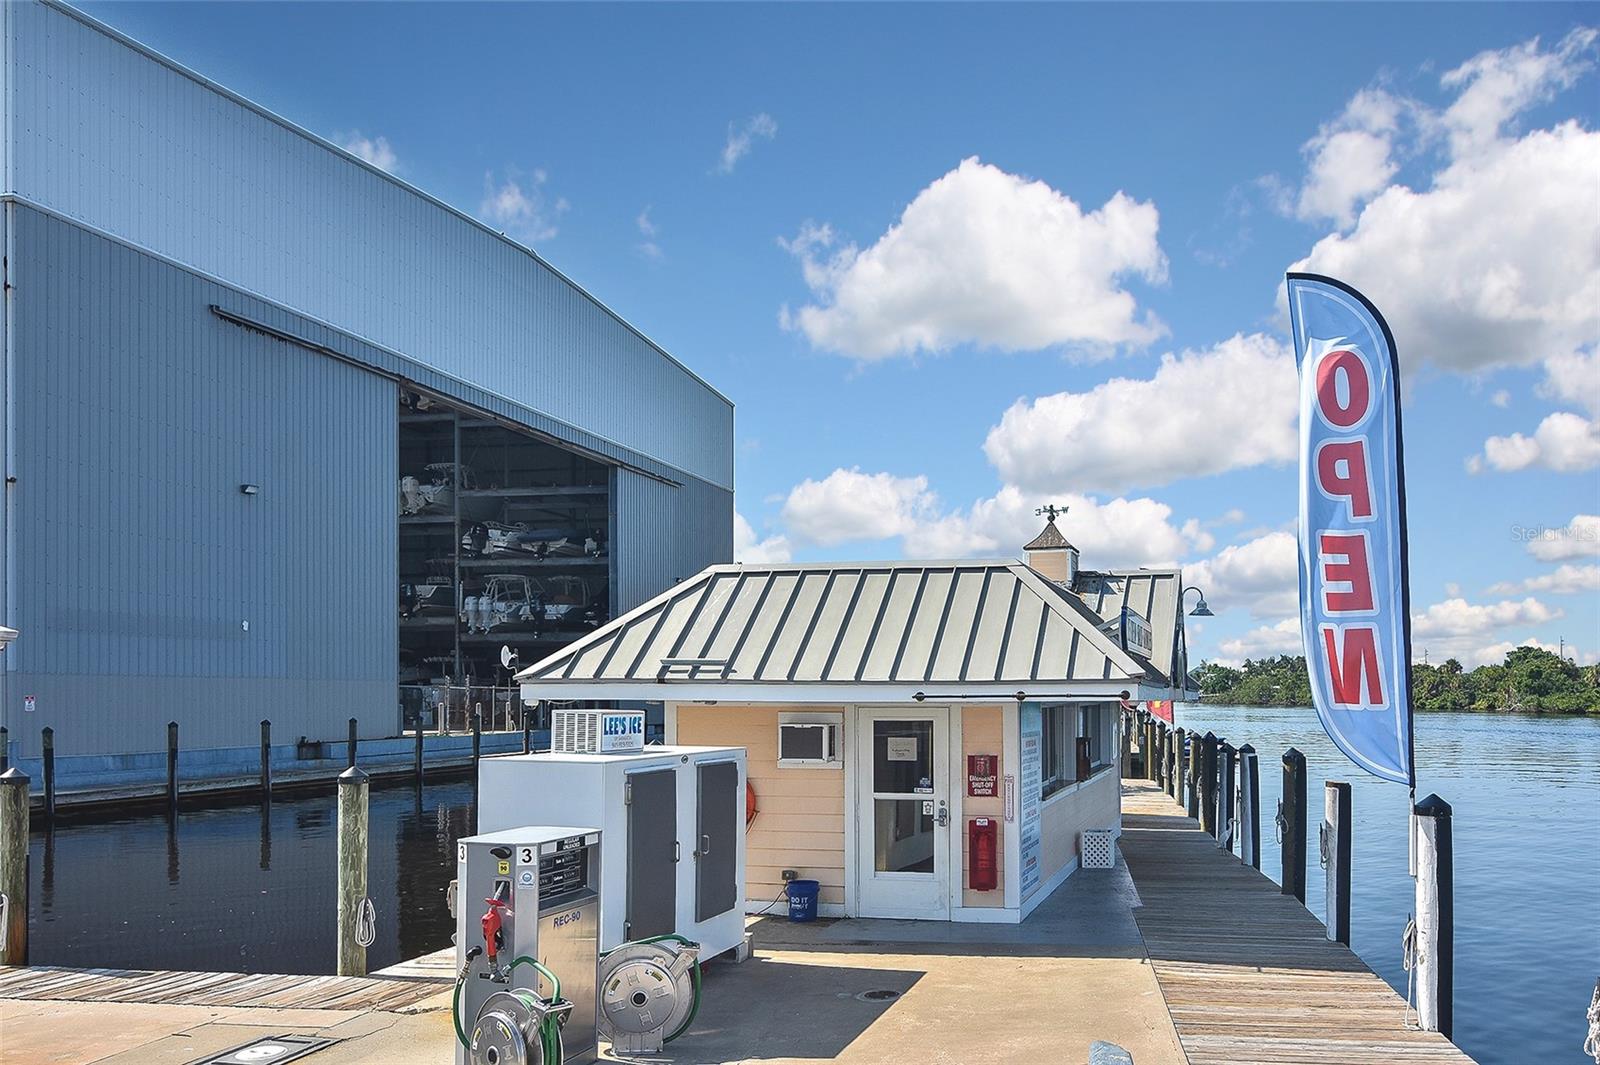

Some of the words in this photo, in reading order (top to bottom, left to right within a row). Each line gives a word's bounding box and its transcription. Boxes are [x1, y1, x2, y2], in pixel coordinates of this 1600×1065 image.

[604, 717, 626, 735] LEE'S
[629, 716, 642, 734] ICE
[459, 845, 465, 861] 3
[521, 848, 533, 863] 3
[553, 911, 581, 927] REC-90
